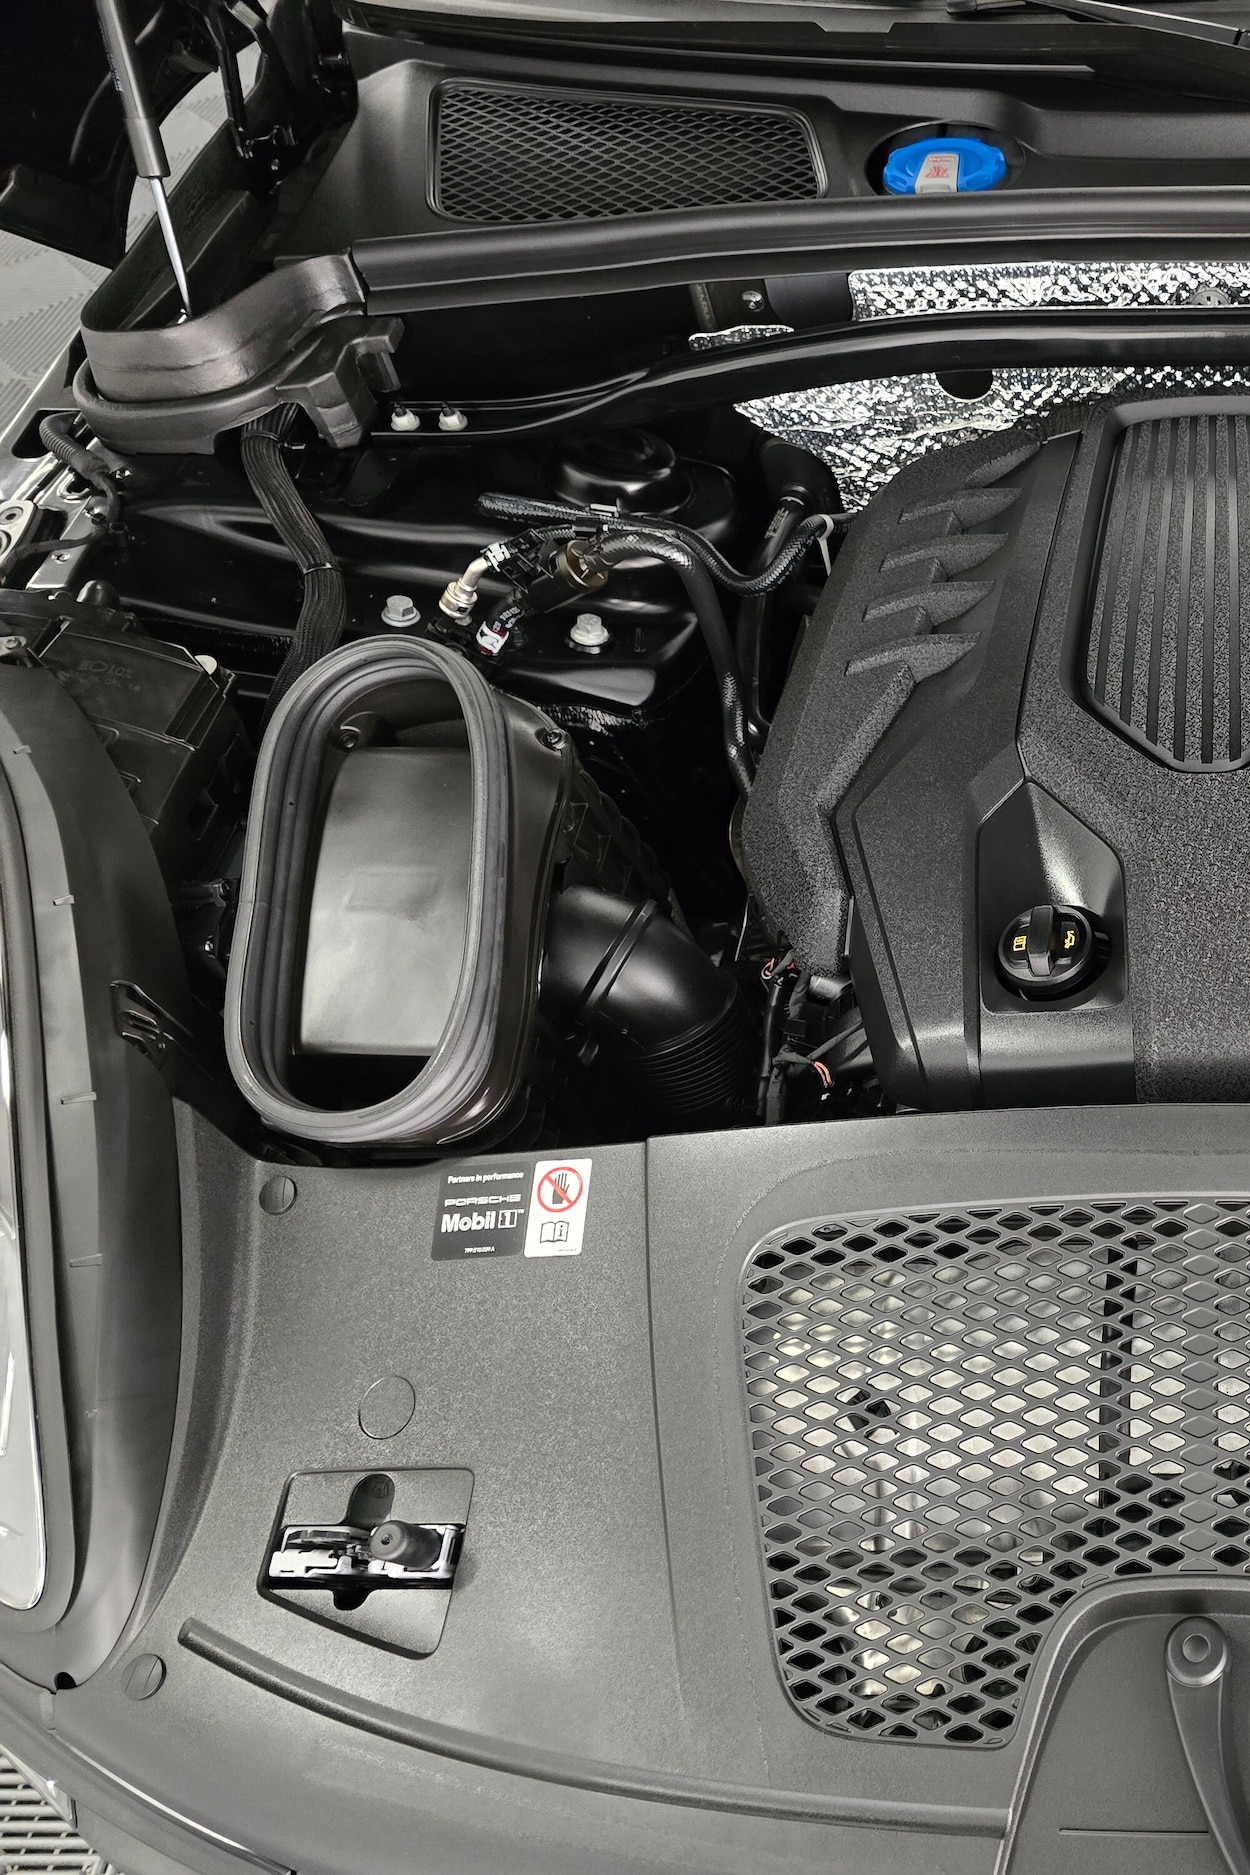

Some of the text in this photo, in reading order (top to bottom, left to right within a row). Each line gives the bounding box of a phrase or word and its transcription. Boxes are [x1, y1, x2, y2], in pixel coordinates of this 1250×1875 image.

[447, 1172, 524, 1184] Partners in performance
[444, 1194, 522, 1207] PORSCHE
[441, 1211, 497, 1233] Mobil
